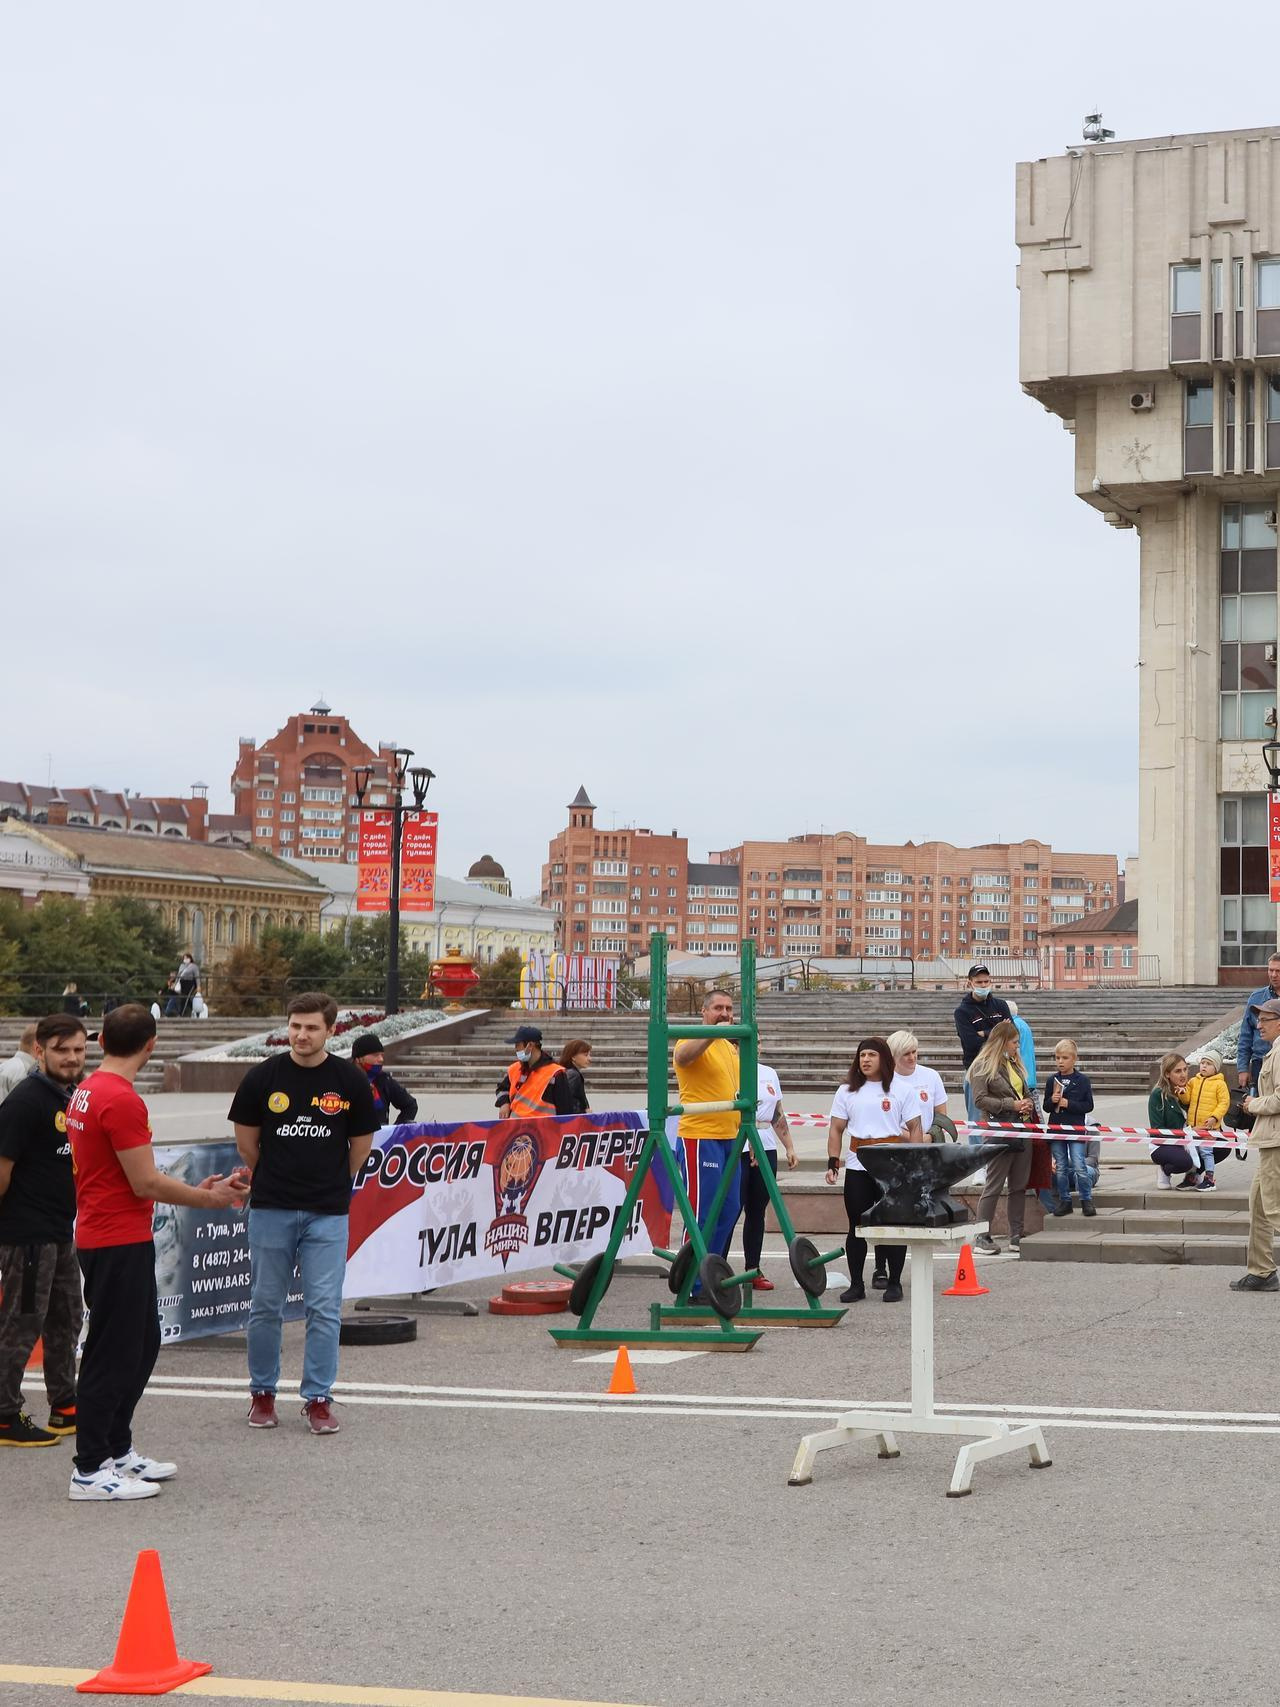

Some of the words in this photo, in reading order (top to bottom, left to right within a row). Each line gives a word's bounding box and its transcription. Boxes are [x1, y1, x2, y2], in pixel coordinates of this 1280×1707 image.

[276, 1124, 331, 1138] «ВОСТОК»
[353, 1140, 487, 1190] РОССИЯ
[196, 1227, 204, 1238] г.
[206, 1222, 230, 1240] Тула,
[232, 1222, 246, 1237] ул.
[485, 1223, 528, 1246] НАЦИЯ
[418, 1221, 477, 1268] ТУЛА
[493, 1239, 518, 1254] МИРА
[192, 1254, 199, 1269] 8
[202, 1250, 231, 1271] (4872)
[958, 1269, 966, 1280] 8
[191, 1306, 214, 1319] ЗАКАЗ
[215, 1301, 239, 1315] УСЛУГИ
